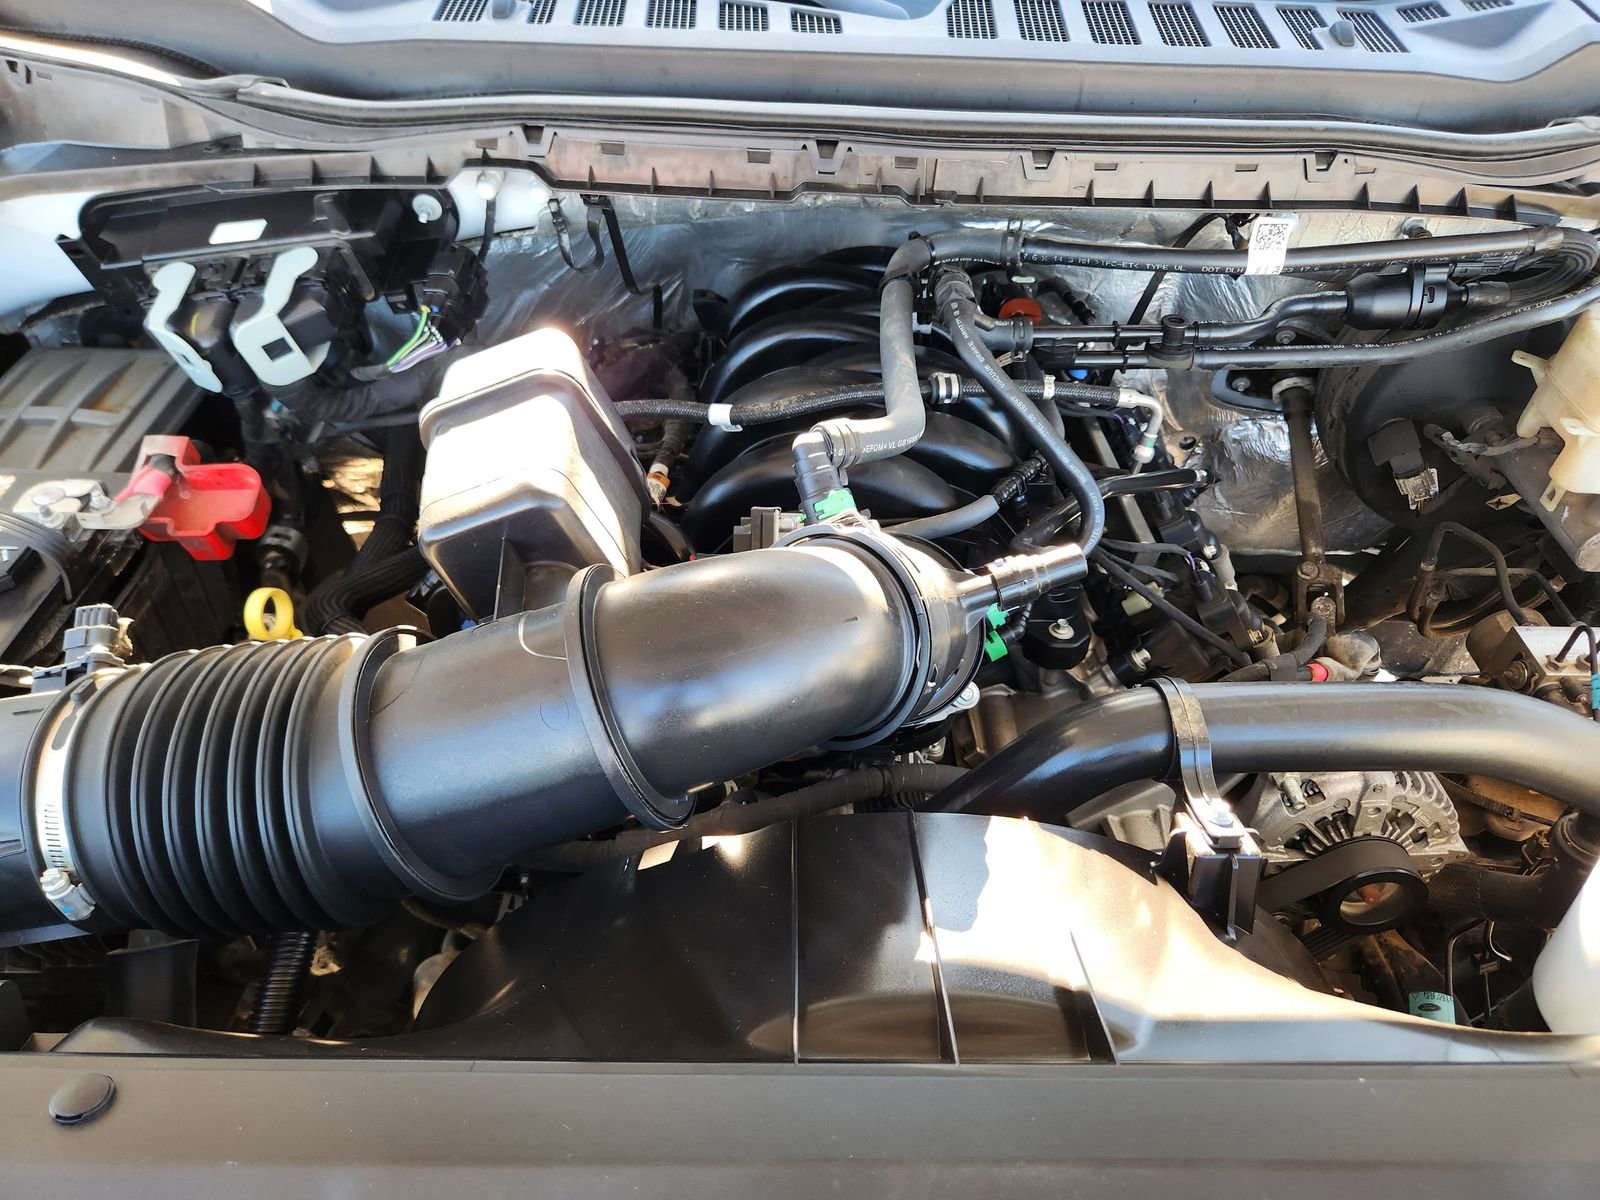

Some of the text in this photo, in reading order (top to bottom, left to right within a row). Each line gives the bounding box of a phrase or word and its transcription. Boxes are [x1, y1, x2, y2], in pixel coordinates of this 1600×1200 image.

[1145, 263, 1169, 272] TYPE
[1201, 265, 1222, 273] DOT
[967, 340, 986, 363] BRAKE
[984, 363, 1006, 389] VACUUM
